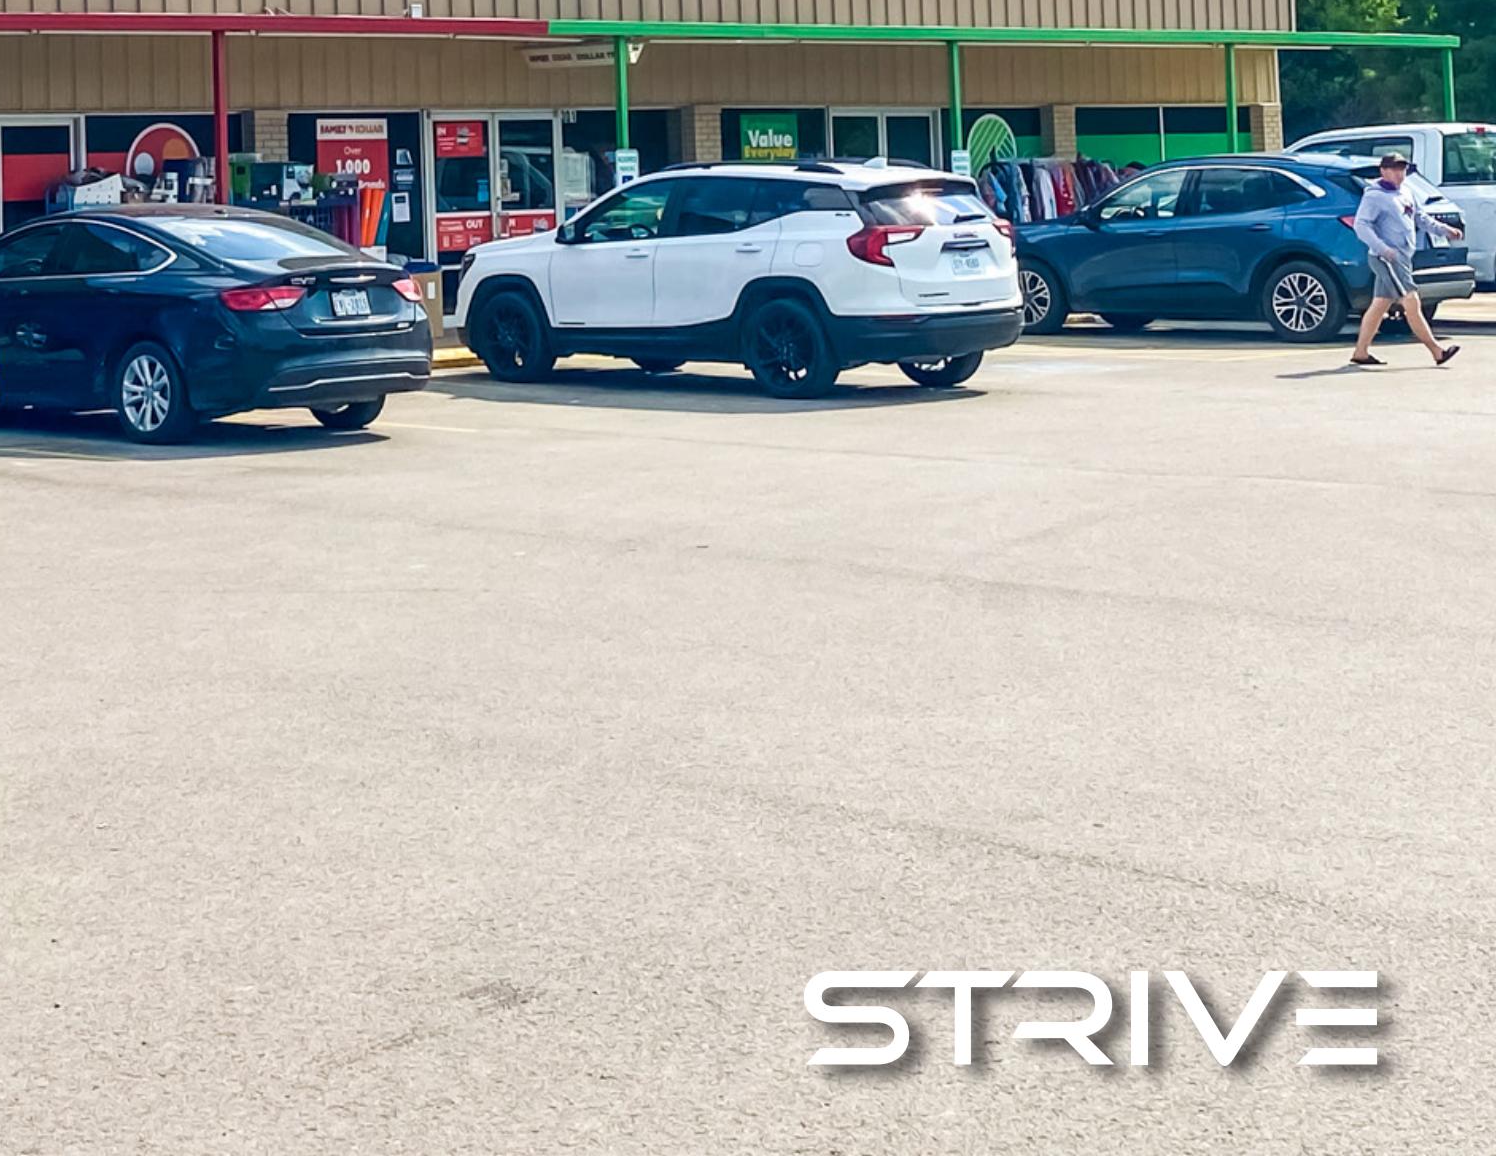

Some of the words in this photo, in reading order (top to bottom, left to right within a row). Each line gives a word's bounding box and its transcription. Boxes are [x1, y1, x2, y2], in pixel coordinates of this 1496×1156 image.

[747, 128, 793, 148] Value
[343, 146, 363, 156] Over
[744, 145, 797, 161] Everyday
[466, 218, 484, 229] OUT
